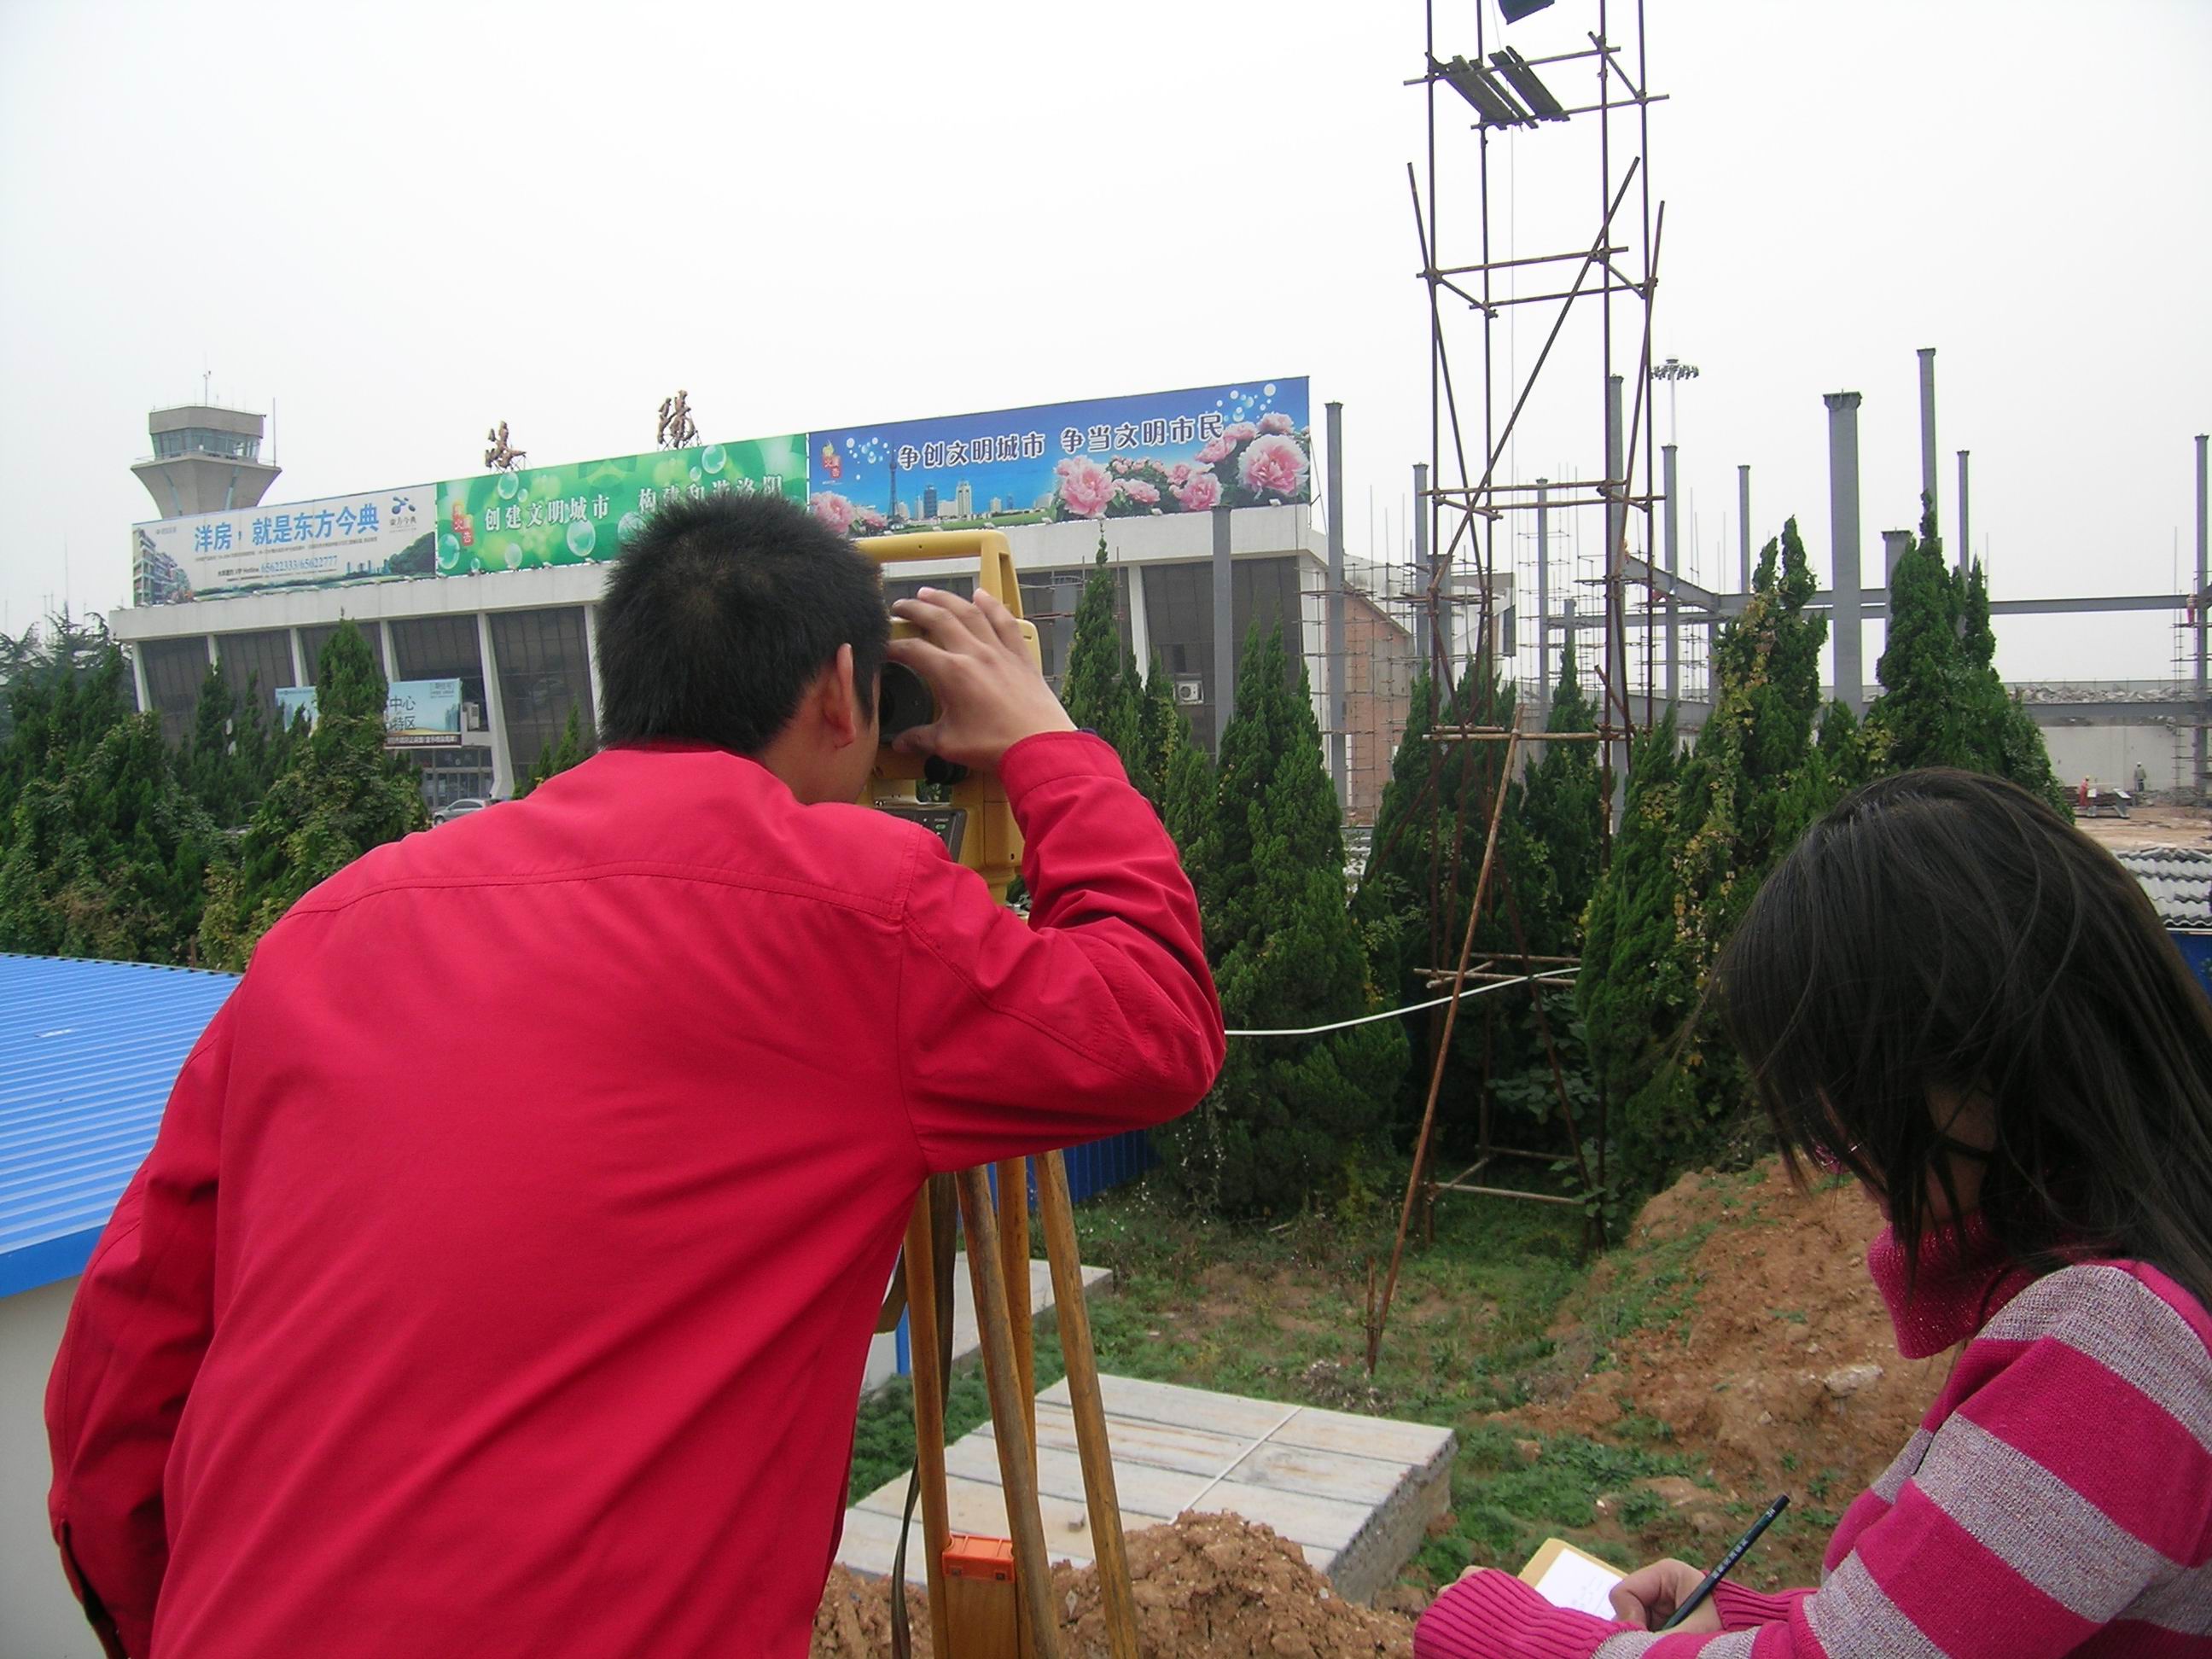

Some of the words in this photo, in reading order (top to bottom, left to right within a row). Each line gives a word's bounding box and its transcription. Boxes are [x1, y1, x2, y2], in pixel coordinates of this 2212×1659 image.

[898, 434, 1046, 469] 争创文明城市
[1061, 414, 1223, 454] 争当文明市民
[485, 493, 610, 532] 创建文明城市
[389, 696, 416, 712] 中心
